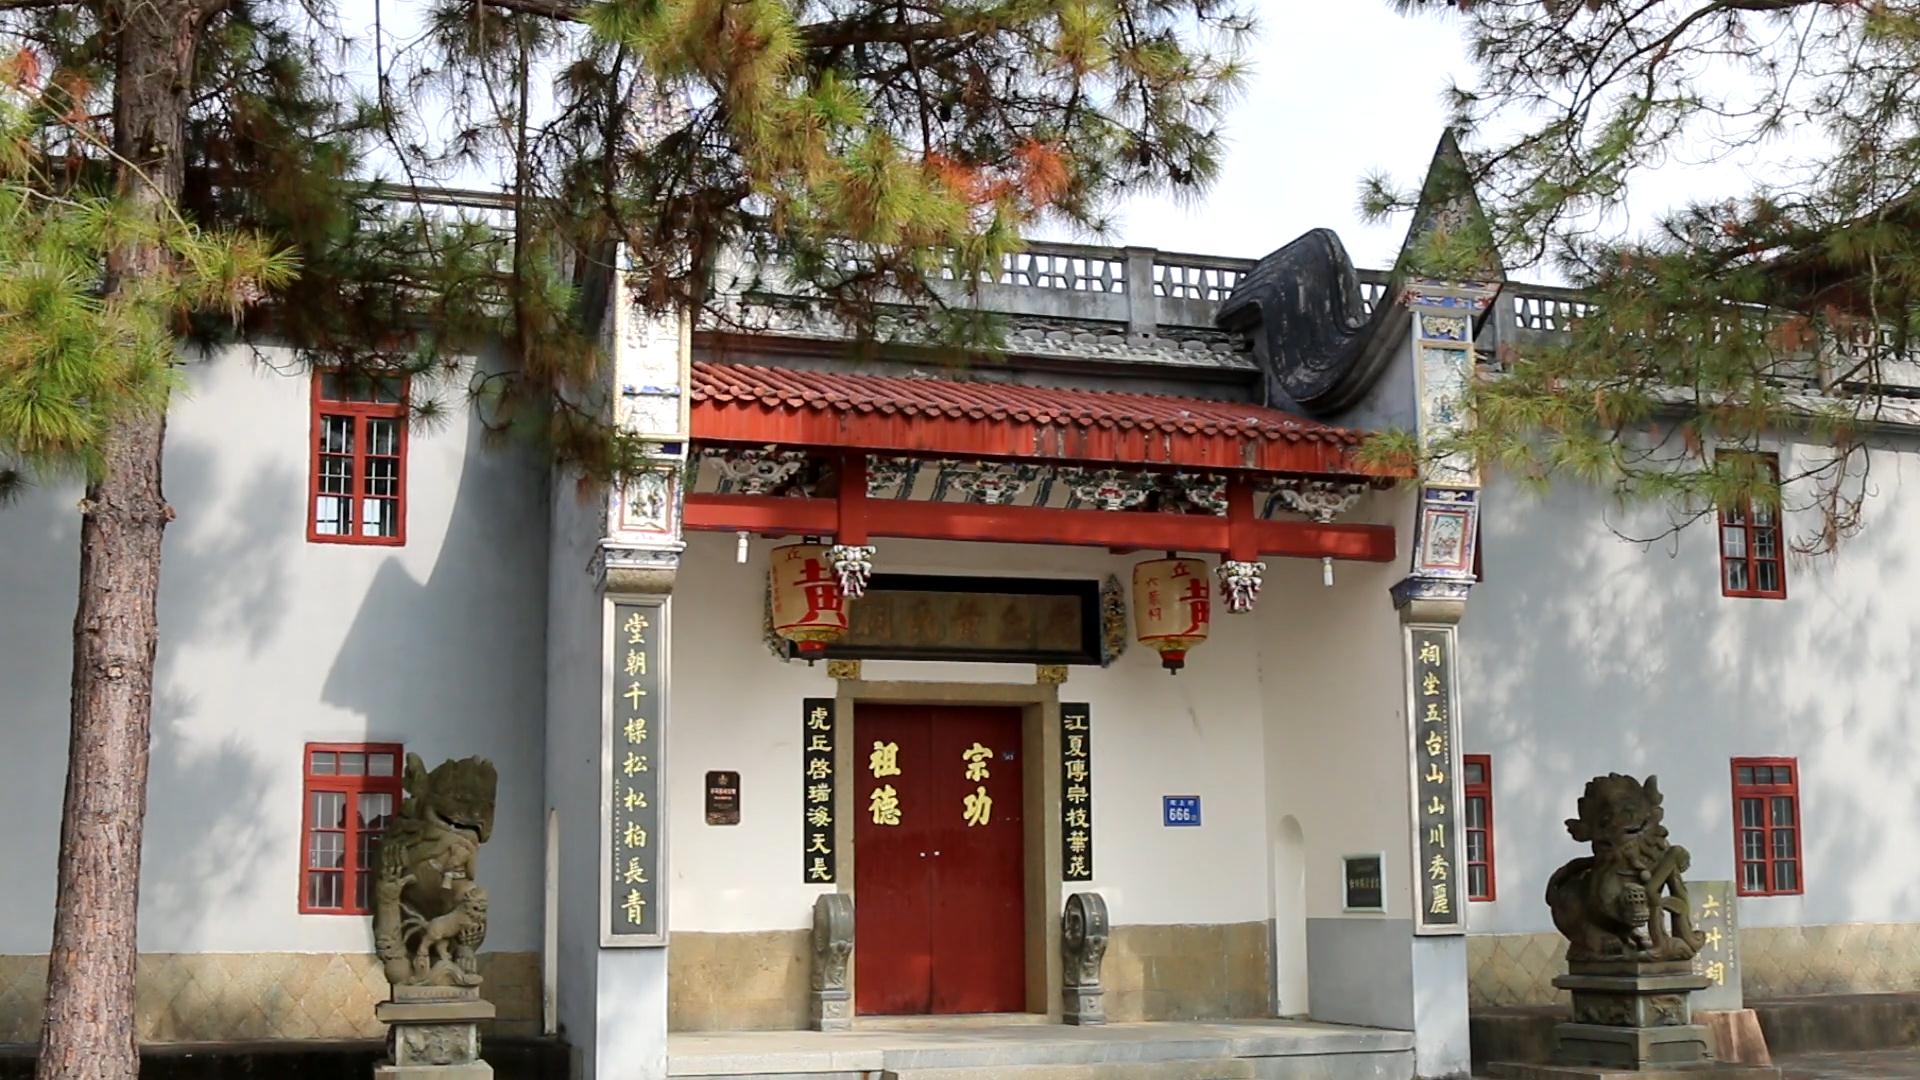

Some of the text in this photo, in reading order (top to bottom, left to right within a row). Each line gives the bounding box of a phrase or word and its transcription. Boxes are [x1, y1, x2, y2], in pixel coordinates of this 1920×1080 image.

[621, 612, 649, 926] 堂朝千棵松松柏長青
[962, 742, 993, 827] 宗功
